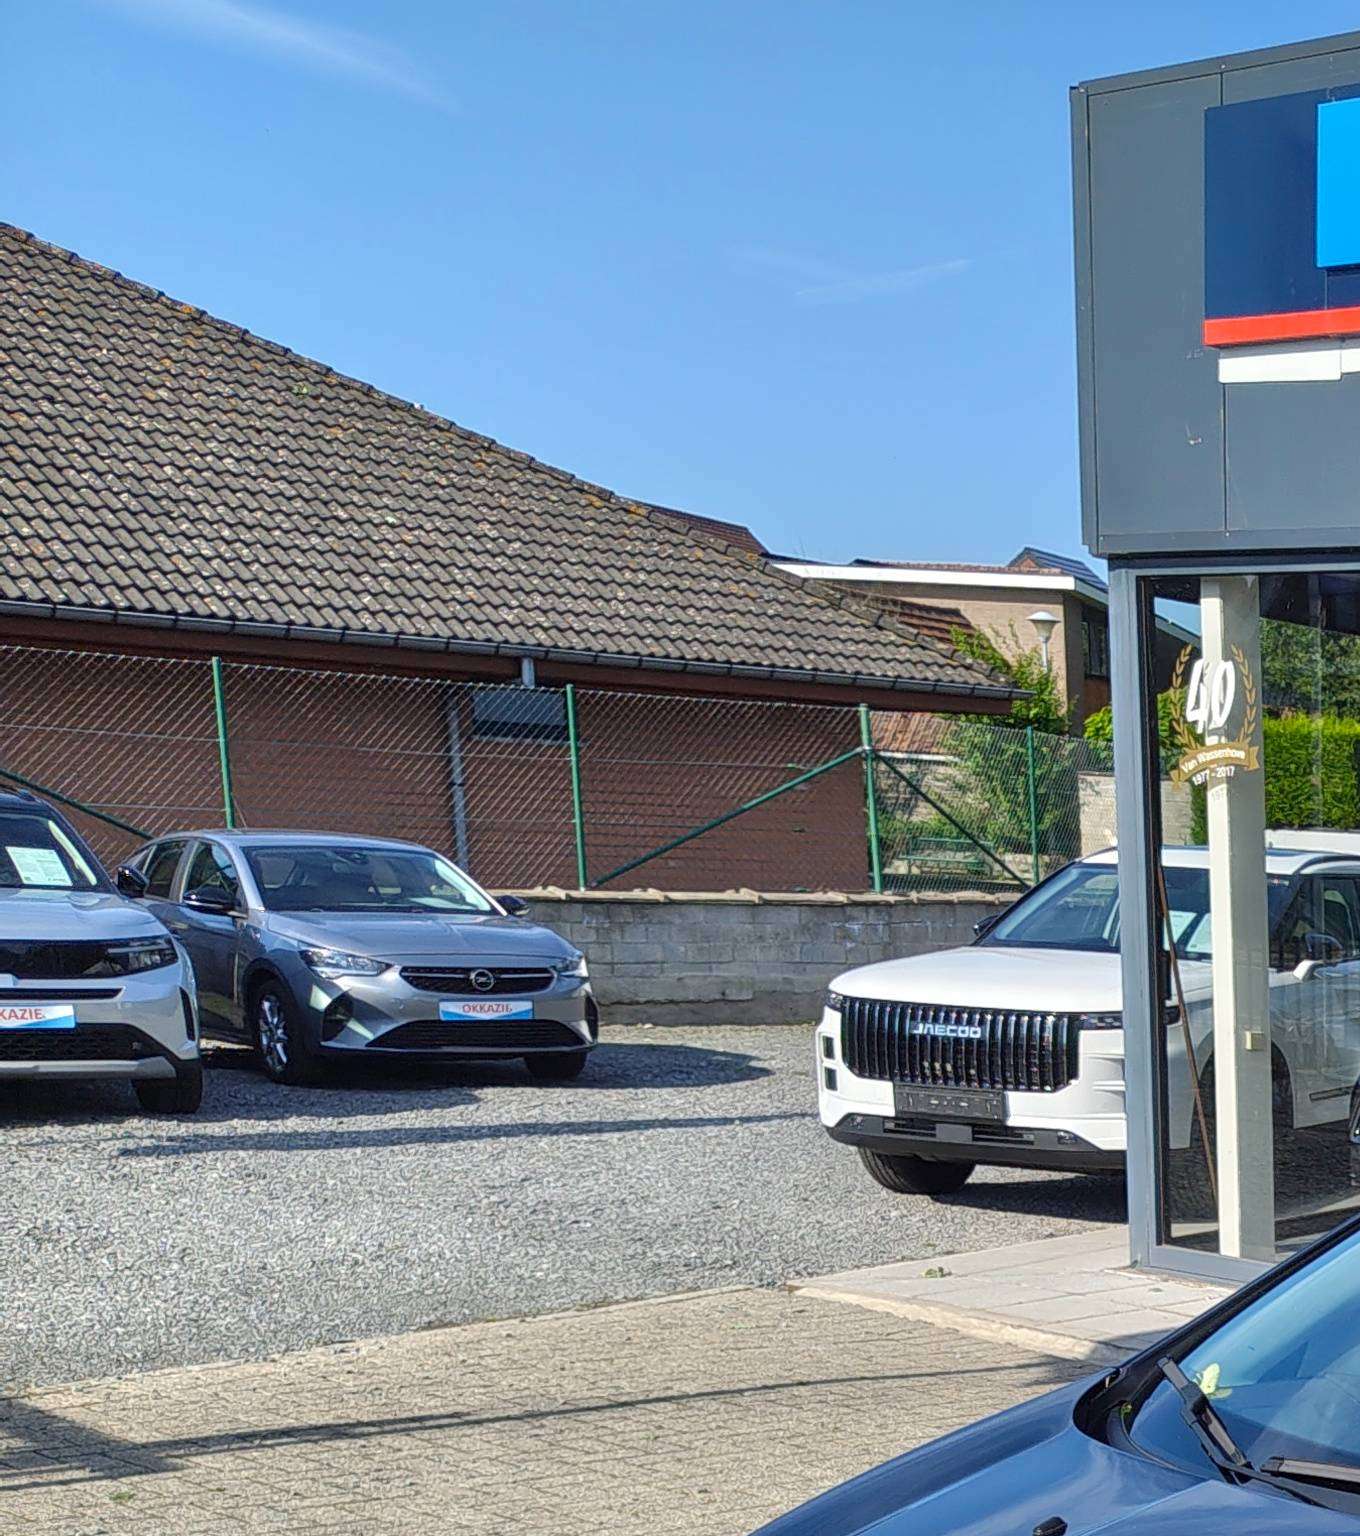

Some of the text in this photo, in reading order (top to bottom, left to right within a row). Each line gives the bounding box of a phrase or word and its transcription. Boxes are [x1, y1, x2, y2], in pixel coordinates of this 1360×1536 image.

[1185, 657, 1236, 734] 40
[1216, 766, 1235, 778] 2017
[462, 1003, 510, 1014] OKKAZIE
[911, 1023, 982, 1039] JAECOO
